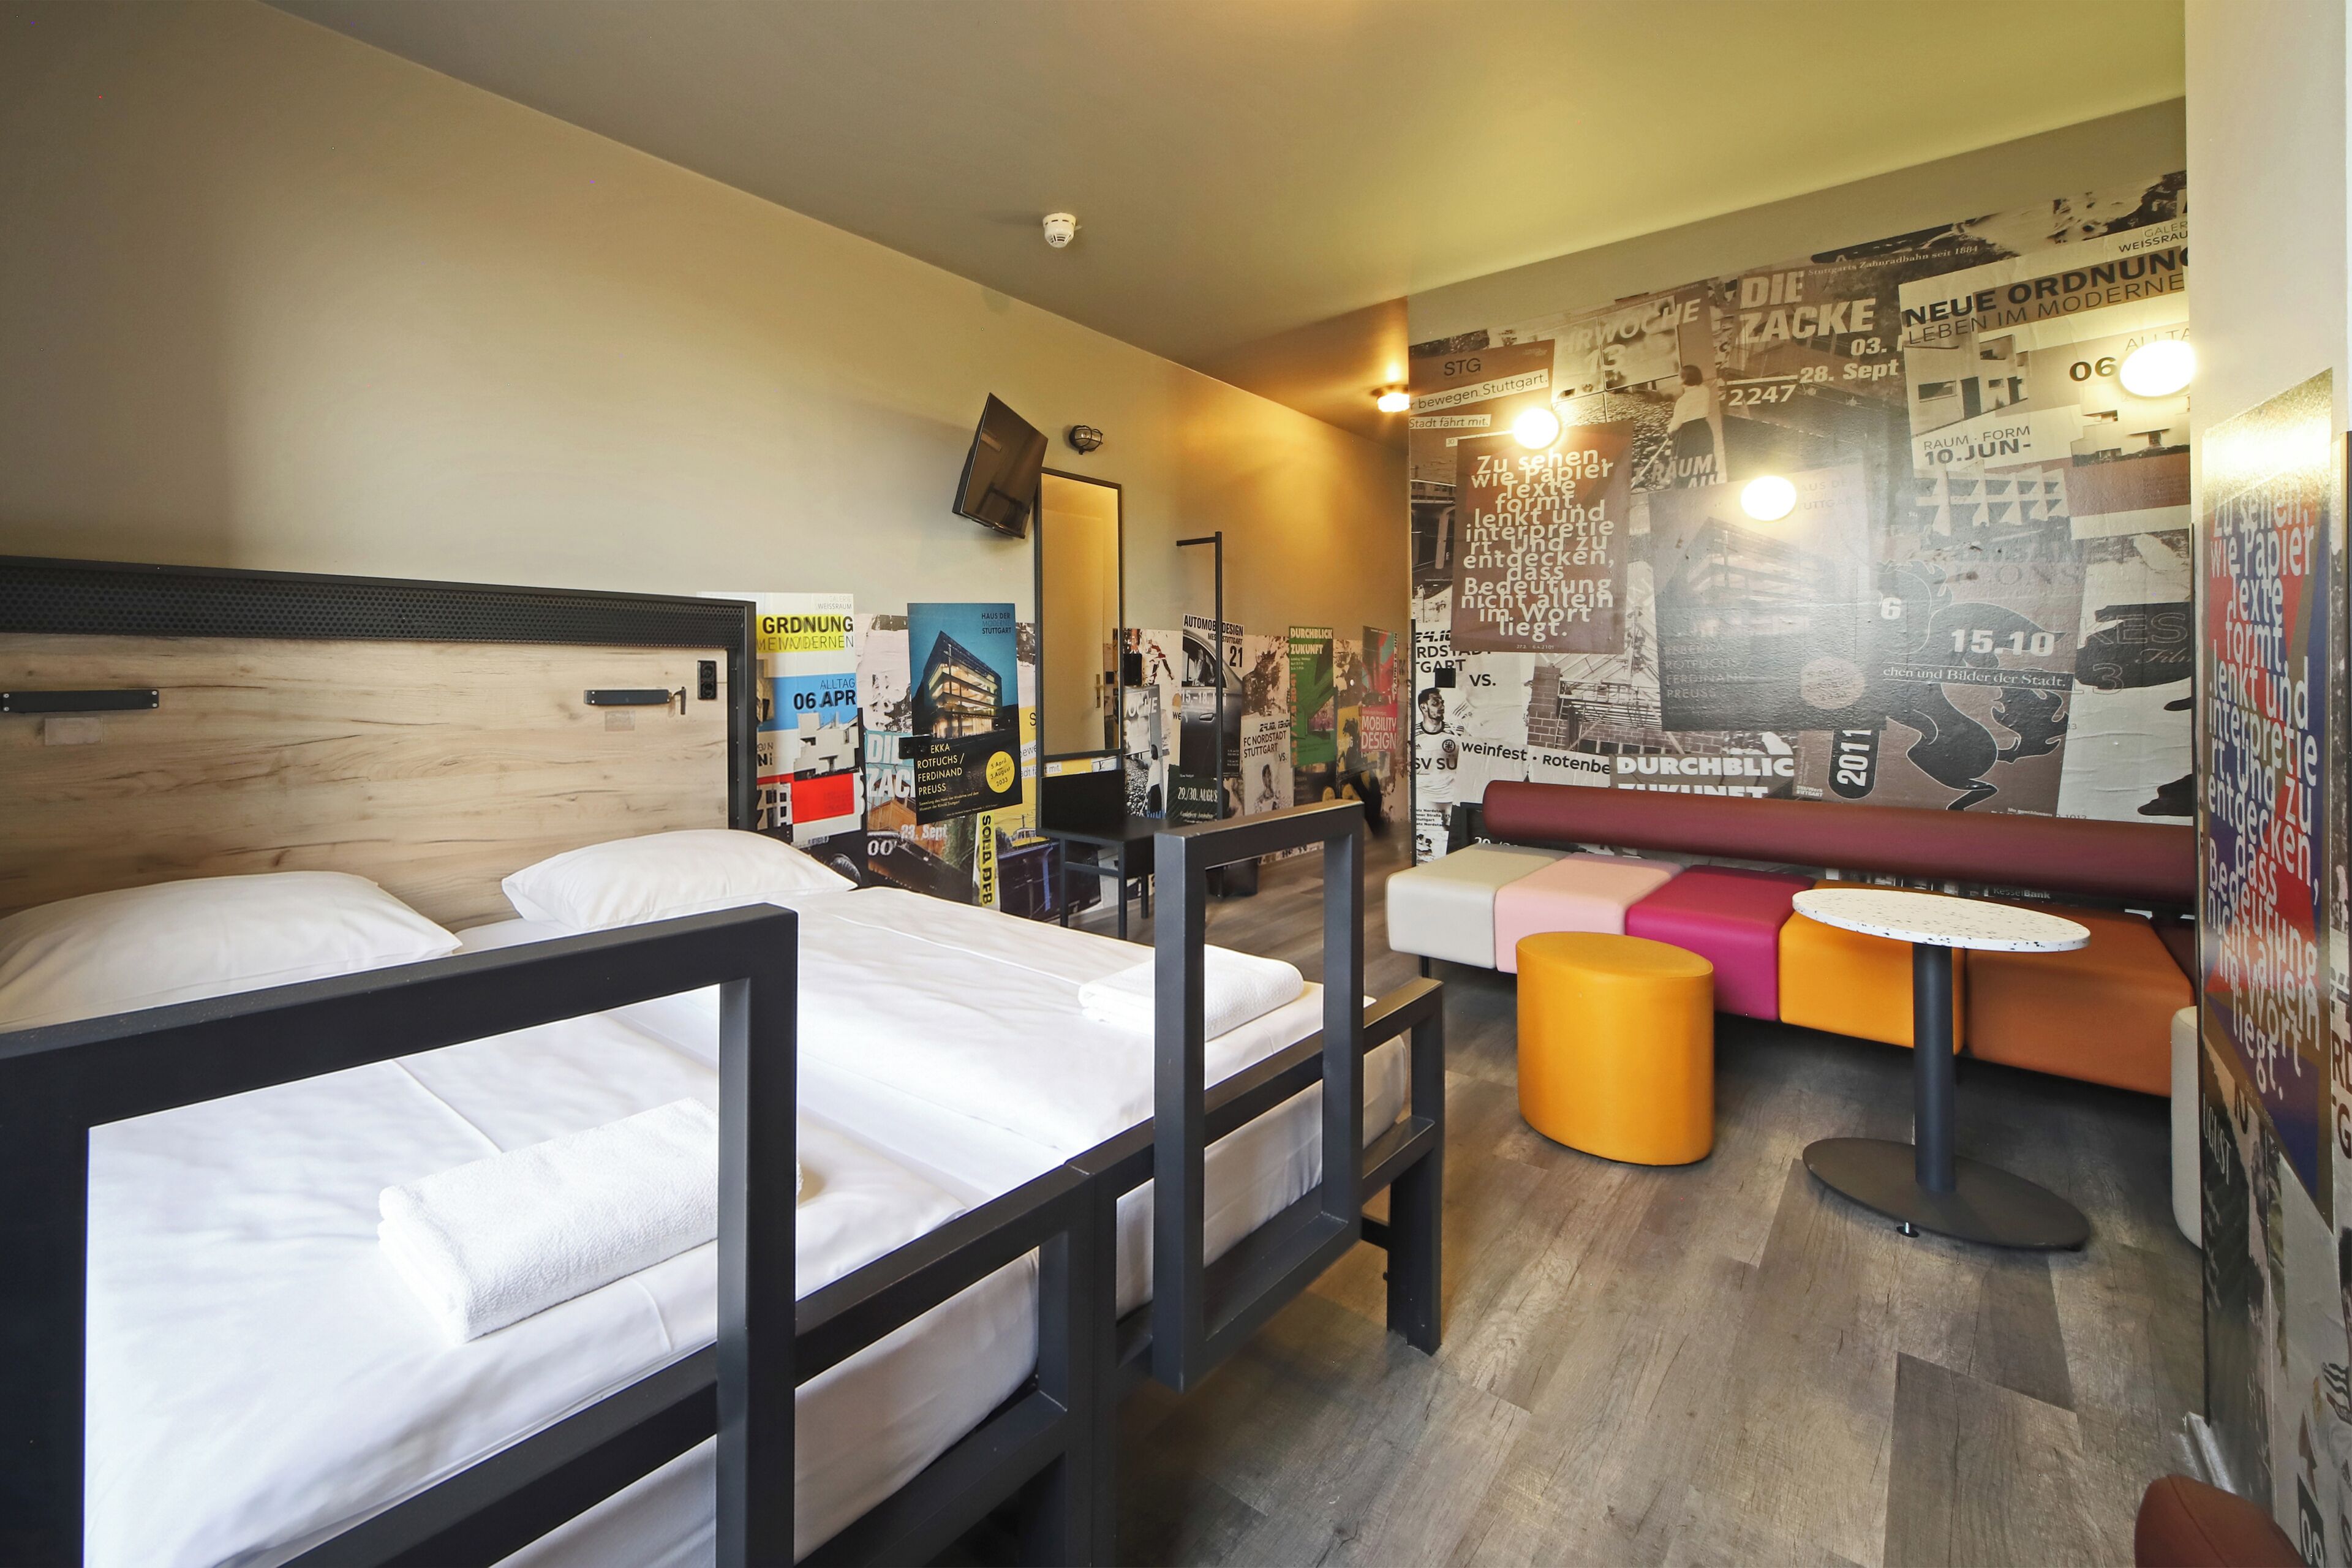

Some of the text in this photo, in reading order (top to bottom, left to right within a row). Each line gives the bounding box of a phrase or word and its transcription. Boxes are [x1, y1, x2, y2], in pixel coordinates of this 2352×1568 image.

[1808, 245, 1978, 276] Stuttgarts Zahnradbahn seit 1884
[1740, 271, 1806, 309] DIE
[1905, 290, 1997, 327] NEUE
[1909, 273, 2185, 345] LEBEN IM MODERNE
[1736, 298, 1876, 345] ZACKE
[1850, 337, 1887, 356] 03.
[1444, 358, 1481, 375] STG
[1800, 359, 1899, 384] 28. Sept
[2070, 356, 2117, 382] 06
[1419, 390, 1478, 410] bewegen
[1483, 373, 1548, 396] Stuttgart.
[1728, 385, 1796, 406] 2247
[1409, 417, 1488, 428] Stadt fährt mit.
[1924, 425, 2030, 451] RAUM FORM
[1477, 448, 1607, 475] Zu sehen,
[1471, 462, 1614, 489] wie Papier
[1504, 479, 1576, 500] Texte
[1474, 499, 1605, 529] lenkt und
[1496, 492, 1582, 514] formt,
[2214, 499, 2233, 538] Zu
[1466, 519, 1615, 545] interpretie
[1510, 534, 1564, 554] Und
[1575, 535, 1608, 551] zu
[1463, 546, 1614, 568] entdecken,
[2211, 524, 2315, 597] wie Papier
[1507, 557, 1565, 581] dass
[1461, 587, 1613, 609] nicht allein
[1464, 576, 1612, 598] Bedeutung
[2230, 564, 2284, 626] Texte
[1480, 603, 1593, 623] im Wort
[1880, 597, 1902, 620] 6
[1222, 621, 1243, 636] DESIGN
[1290, 627, 1333, 639] DURCHBLICK
[1499, 615, 1568, 643] liegt.
[2225, 600, 2290, 677] formt,
[1290, 643, 1324, 655] ZUKUNFT
[1951, 629, 2055, 657] 15.10
[1229, 645, 1243, 668] 21
[820, 678, 856, 690] ALLTAG
[1469, 673, 1496, 687] VS.
[1917, 669, 1943, 680] und
[1947, 670, 1991, 683] Bilder
[1994, 673, 2018, 684] der
[2021, 674, 2067, 687] Stadt.
[2214, 638, 2309, 731] lenkt und
[794, 690, 857, 710] 06 APR
[1362, 715, 1397, 731] MOBILITY
[1243, 730, 1287, 747] FC NORDSTADT
[1361, 731, 1397, 750] DESIGN
[2209, 682, 2318, 788] interpretie
[918, 754, 958, 769] ROTFUCHS
[1243, 742, 1278, 758] STUTTGART
[1278, 752, 1287, 762] VS.
[1461, 741, 1528, 762] weinfest
[1836, 729, 1872, 788] 2011
[918, 767, 963, 783] FERDINAND
[1617, 756, 1795, 777] DURCHBLIC
[919, 782, 947, 796] PREUSS
[2236, 738, 2276, 812] Und
[2285, 775, 2312, 837] zu
[2207, 774, 2319, 906] entdecken,
[2235, 827, 2278, 907] dass
[2209, 836, 2318, 1005] Bedeutung
[2207, 888, 2320, 1052] nicht allein
[2220, 934, 2302, 1078] im Wort
[2233, 973, 2284, 1101] liegt.
